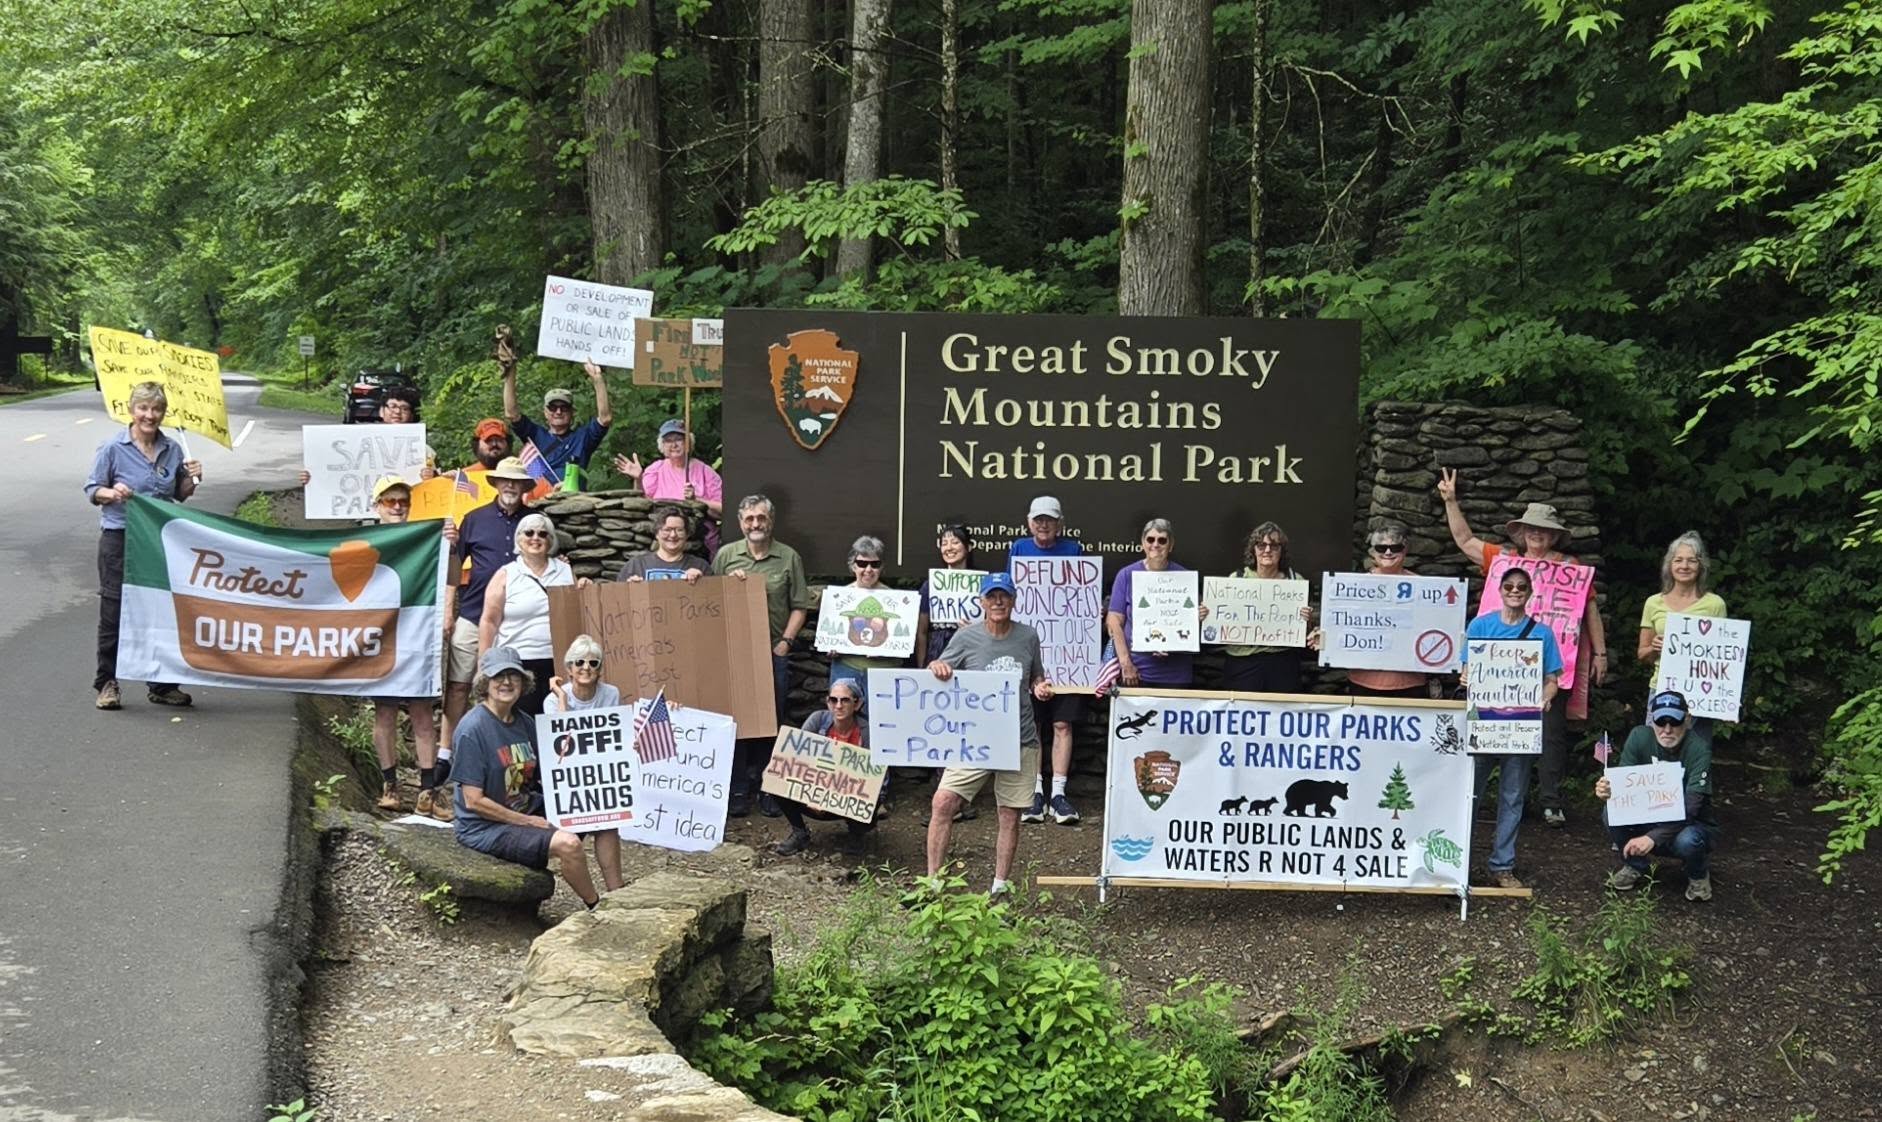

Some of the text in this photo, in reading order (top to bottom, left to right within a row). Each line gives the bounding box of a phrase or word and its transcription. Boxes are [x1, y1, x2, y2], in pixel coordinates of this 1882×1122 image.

[548, 284, 650, 308] NO DEVELOPMENT
[566, 303, 632, 320] OR SALE OF
[551, 317, 592, 336] PUBLIC
[697, 323, 723, 340] TRU
[556, 337, 626, 357] HANDS OFF!
[805, 359, 852, 368] NATIONAL
[941, 333, 1280, 389] Great Smoky
[810, 375, 846, 384] SERVICE
[940, 387, 1223, 430] Mountains
[327, 435, 424, 472] SAVE
[938, 441, 1303, 484] National Park
[340, 472, 401, 495] OU
[937, 524, 1028, 536] Nonal Park
[1099, 541, 1144, 552] Interio
[189, 548, 307, 599] Protect
[933, 571, 985, 592] SUPPORT
[1015, 560, 1099, 585] DEFUND
[1206, 580, 1262, 600] National
[1422, 588, 1442, 604] up
[930, 595, 981, 621] PARKS
[1015, 586, 1099, 618] CONGRESS
[585, 595, 721, 637] National Parks
[1332, 611, 1397, 628] Thanks,
[195, 616, 383, 658] OUR PARKS
[1065, 618, 1096, 644] OUR
[1220, 625, 1252, 641] NOT
[1682, 617, 1739, 639] I the
[604, 638, 676, 666] America's
[1344, 633, 1383, 649] Don!
[1040, 646, 1096, 665] TIONAL
[638, 663, 681, 688] Best
[1045, 666, 1090, 687] ARKS
[1471, 662, 1540, 683] America
[1689, 660, 1730, 680] HONK
[1468, 684, 1540, 705] beautiful
[1684, 680, 1694, 693] U
[1718, 684, 1735, 697] the
[1688, 698, 1729, 713] OKIES
[551, 713, 620, 733] HANDS
[924, 714, 976, 735] Our
[1162, 709, 1421, 742] PROTECT OUR PARKS
[553, 729, 622, 757] OFF!
[907, 737, 990, 762] Parks
[1218, 742, 1361, 771] & RANGERS
[552, 762, 631, 790] PUBLIC
[642, 771, 723, 799] merica's
[1625, 772, 1666, 788] SAVE
[554, 786, 633, 815] LANDS
[786, 779, 873, 820] TREASURES
[1611, 786, 1680, 808] THE PARK
[675, 810, 716, 841] idea
[1168, 819, 1406, 851] OUR PUBLIC LANDS &
[1165, 848, 1409, 879] WATERS R NOT 4 SALE
